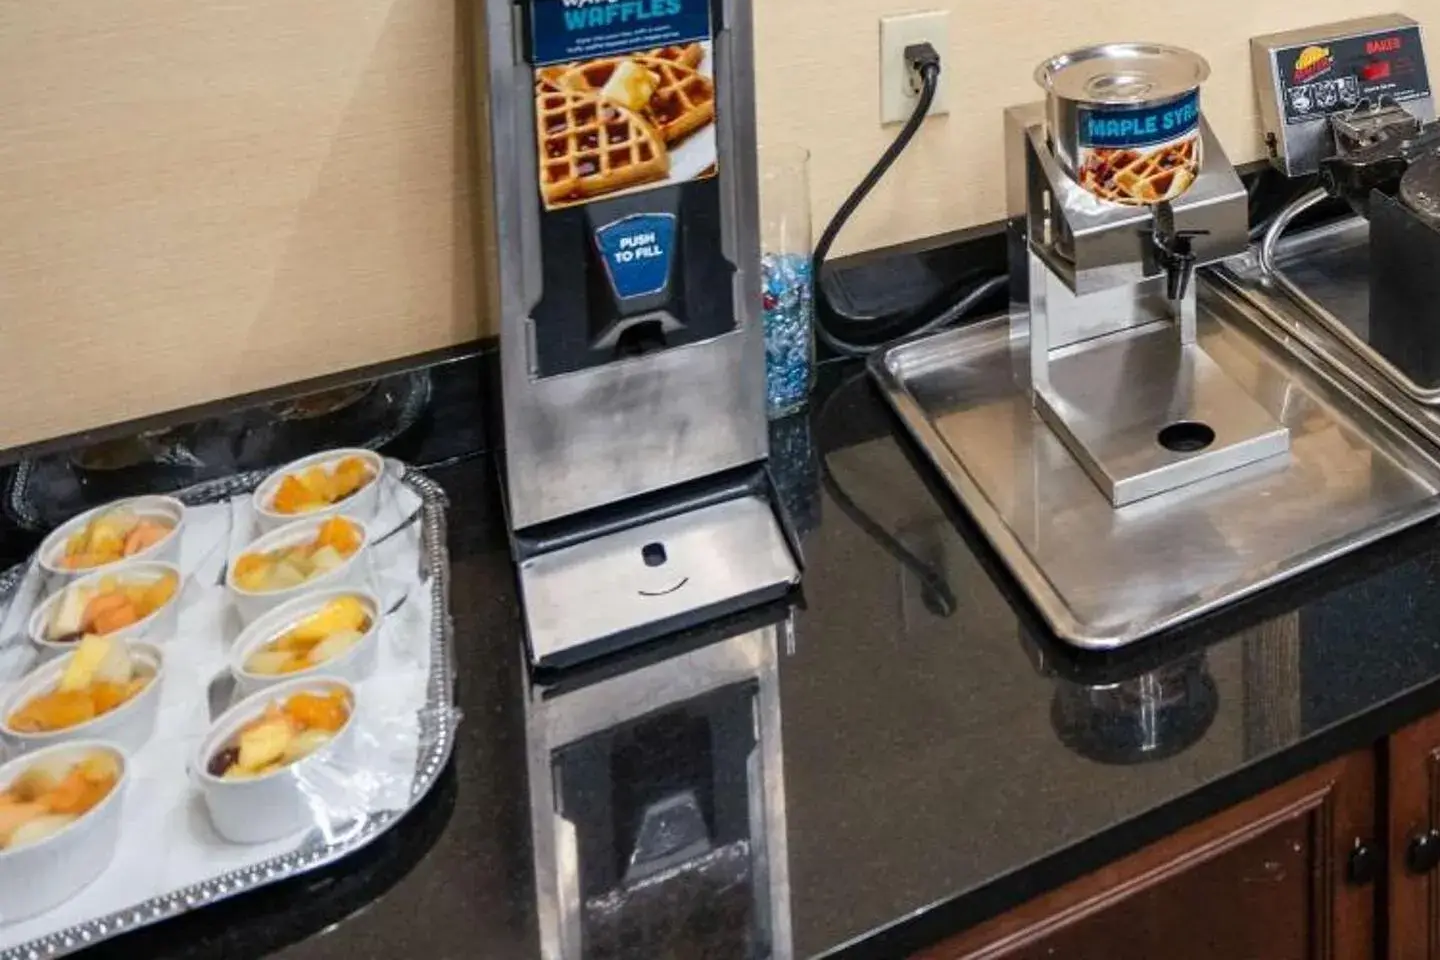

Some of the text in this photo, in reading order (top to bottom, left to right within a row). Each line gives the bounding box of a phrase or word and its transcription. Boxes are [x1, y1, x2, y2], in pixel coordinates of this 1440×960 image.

[1088, 115, 1157, 137] MAPLE
[620, 232, 656, 249] PUSH
[614, 246, 663, 264] TO FILL
